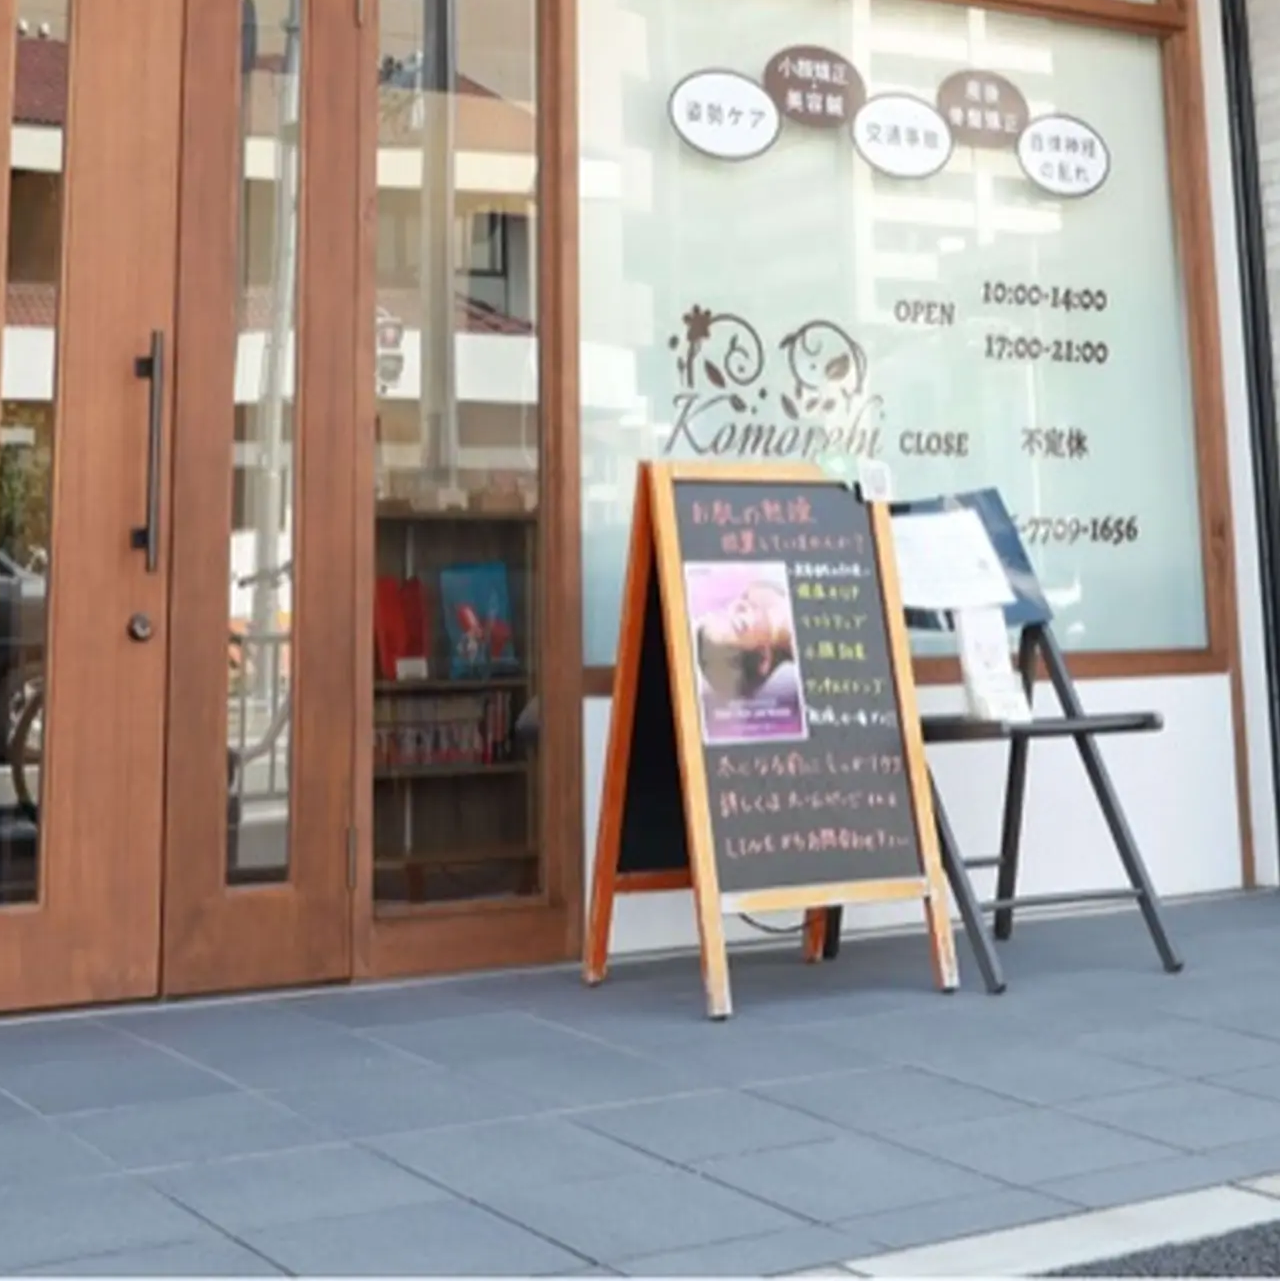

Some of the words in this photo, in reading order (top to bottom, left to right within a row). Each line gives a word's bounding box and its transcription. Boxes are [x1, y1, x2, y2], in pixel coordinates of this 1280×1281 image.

[894, 299, 955, 325] OPEN
[981, 281, 1108, 311] 10:00-14:00
[984, 335, 1109, 364] 17:00-21:00
[899, 430, 969, 457] CLOSE
[1020, 428, 1088, 459] 不定休
[1010, 514, 1138, 545] -7709-1656
